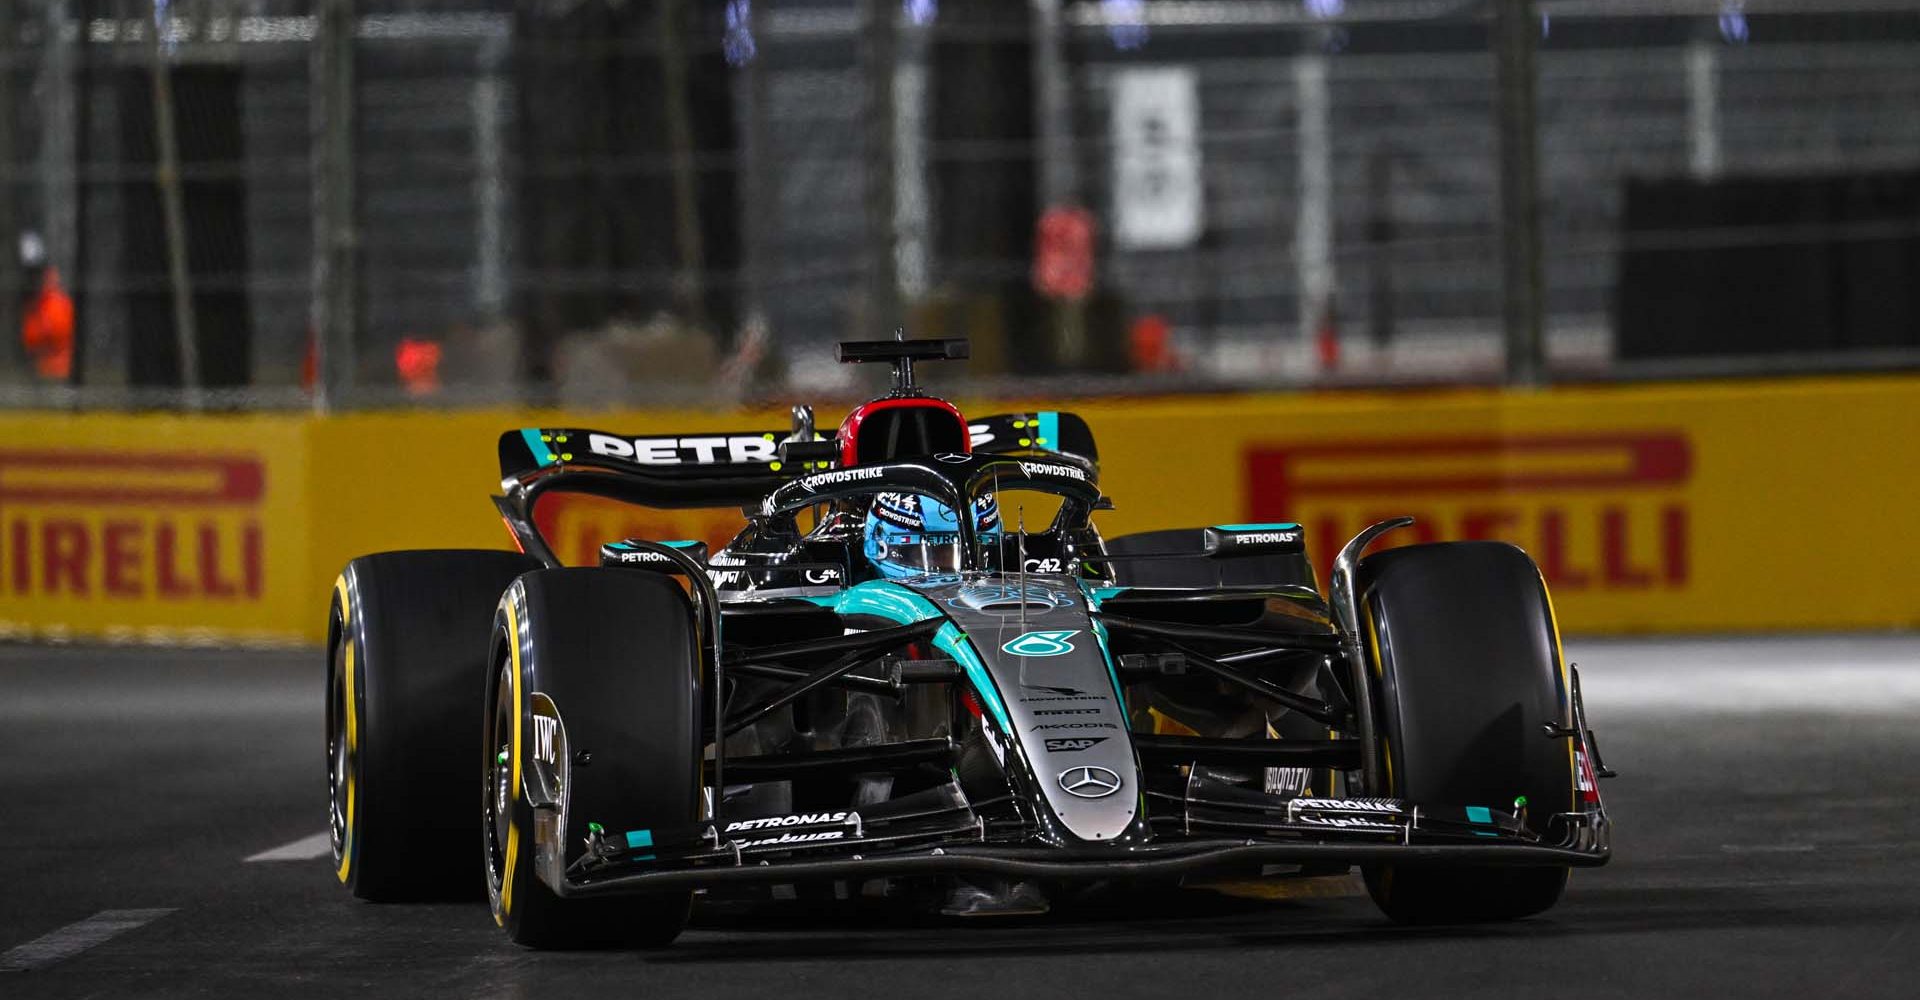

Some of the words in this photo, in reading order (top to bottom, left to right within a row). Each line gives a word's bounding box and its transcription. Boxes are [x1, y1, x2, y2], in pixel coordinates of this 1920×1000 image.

[805, 468, 883, 488] CROWDSTRIKE
[1023, 463, 1085, 481] CROWDSTRIKE
[1236, 533, 1293, 544] PETRONAS
[621, 551, 670, 563] PETRON
[1030, 722, 1117, 732] AKKODIS
[533, 714, 557, 765] IWC
[1047, 739, 1095, 750] SAP
[1294, 798, 1402, 813] PETRONAS
[725, 812, 847, 832] PETRONAS
